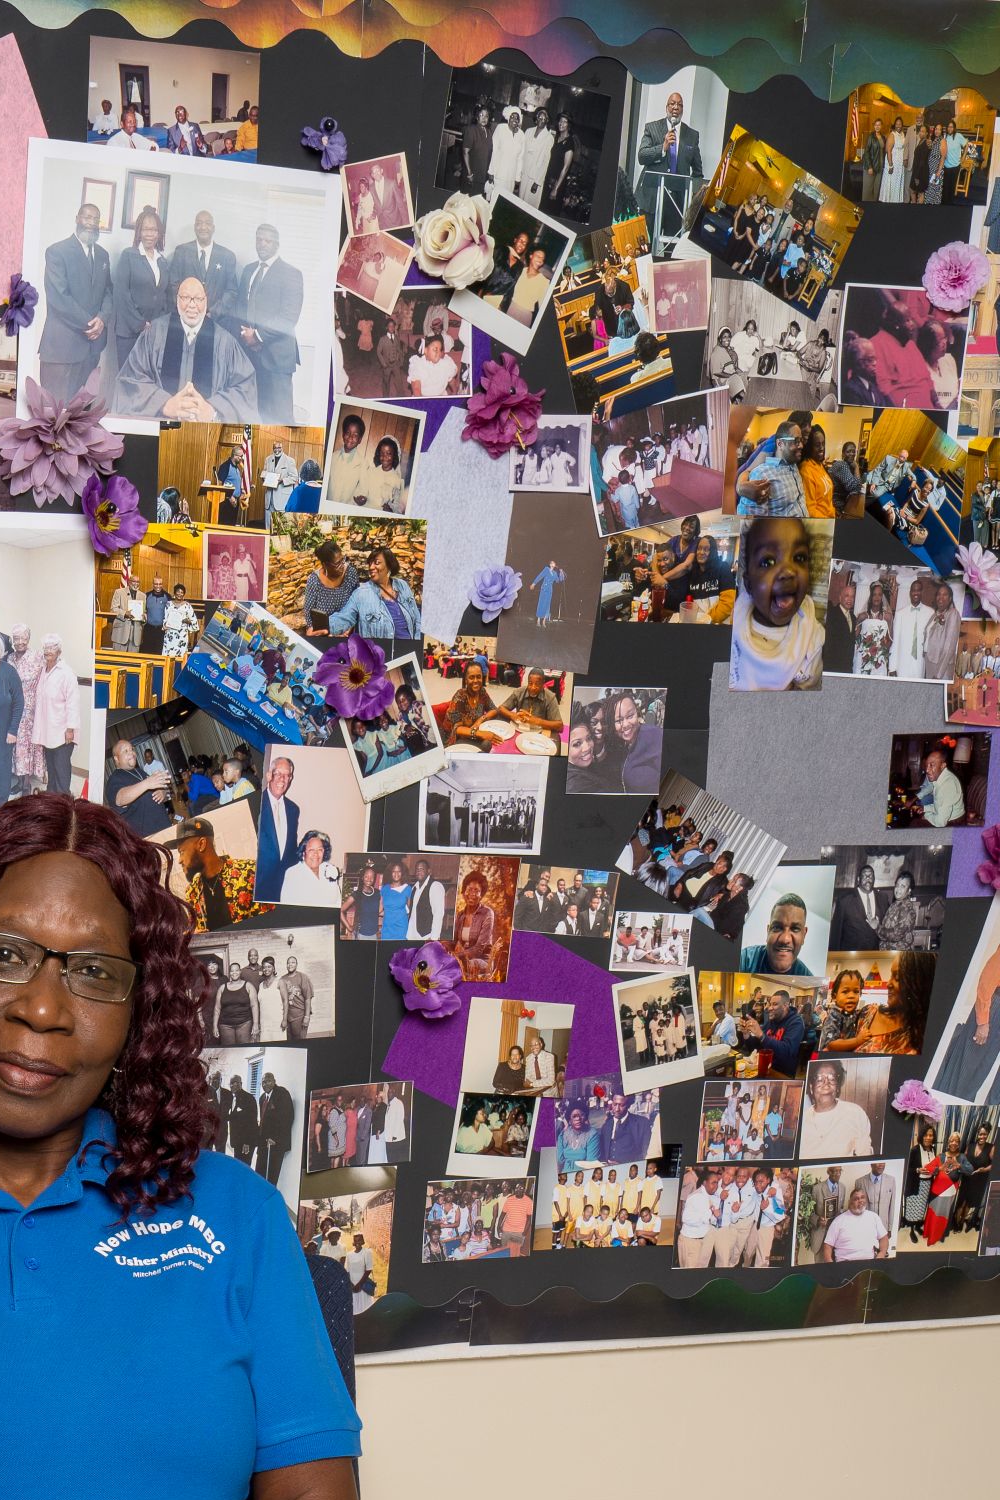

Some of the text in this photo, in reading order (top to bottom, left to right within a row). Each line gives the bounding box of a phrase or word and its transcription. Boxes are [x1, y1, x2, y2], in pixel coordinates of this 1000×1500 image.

[93, 1214, 226, 1257] New Hope MBC
[114, 1244, 214, 1267] Usher Ministry
[132, 1269, 162, 1278] Mitchell
[162, 1260, 187, 1272] Turner,
